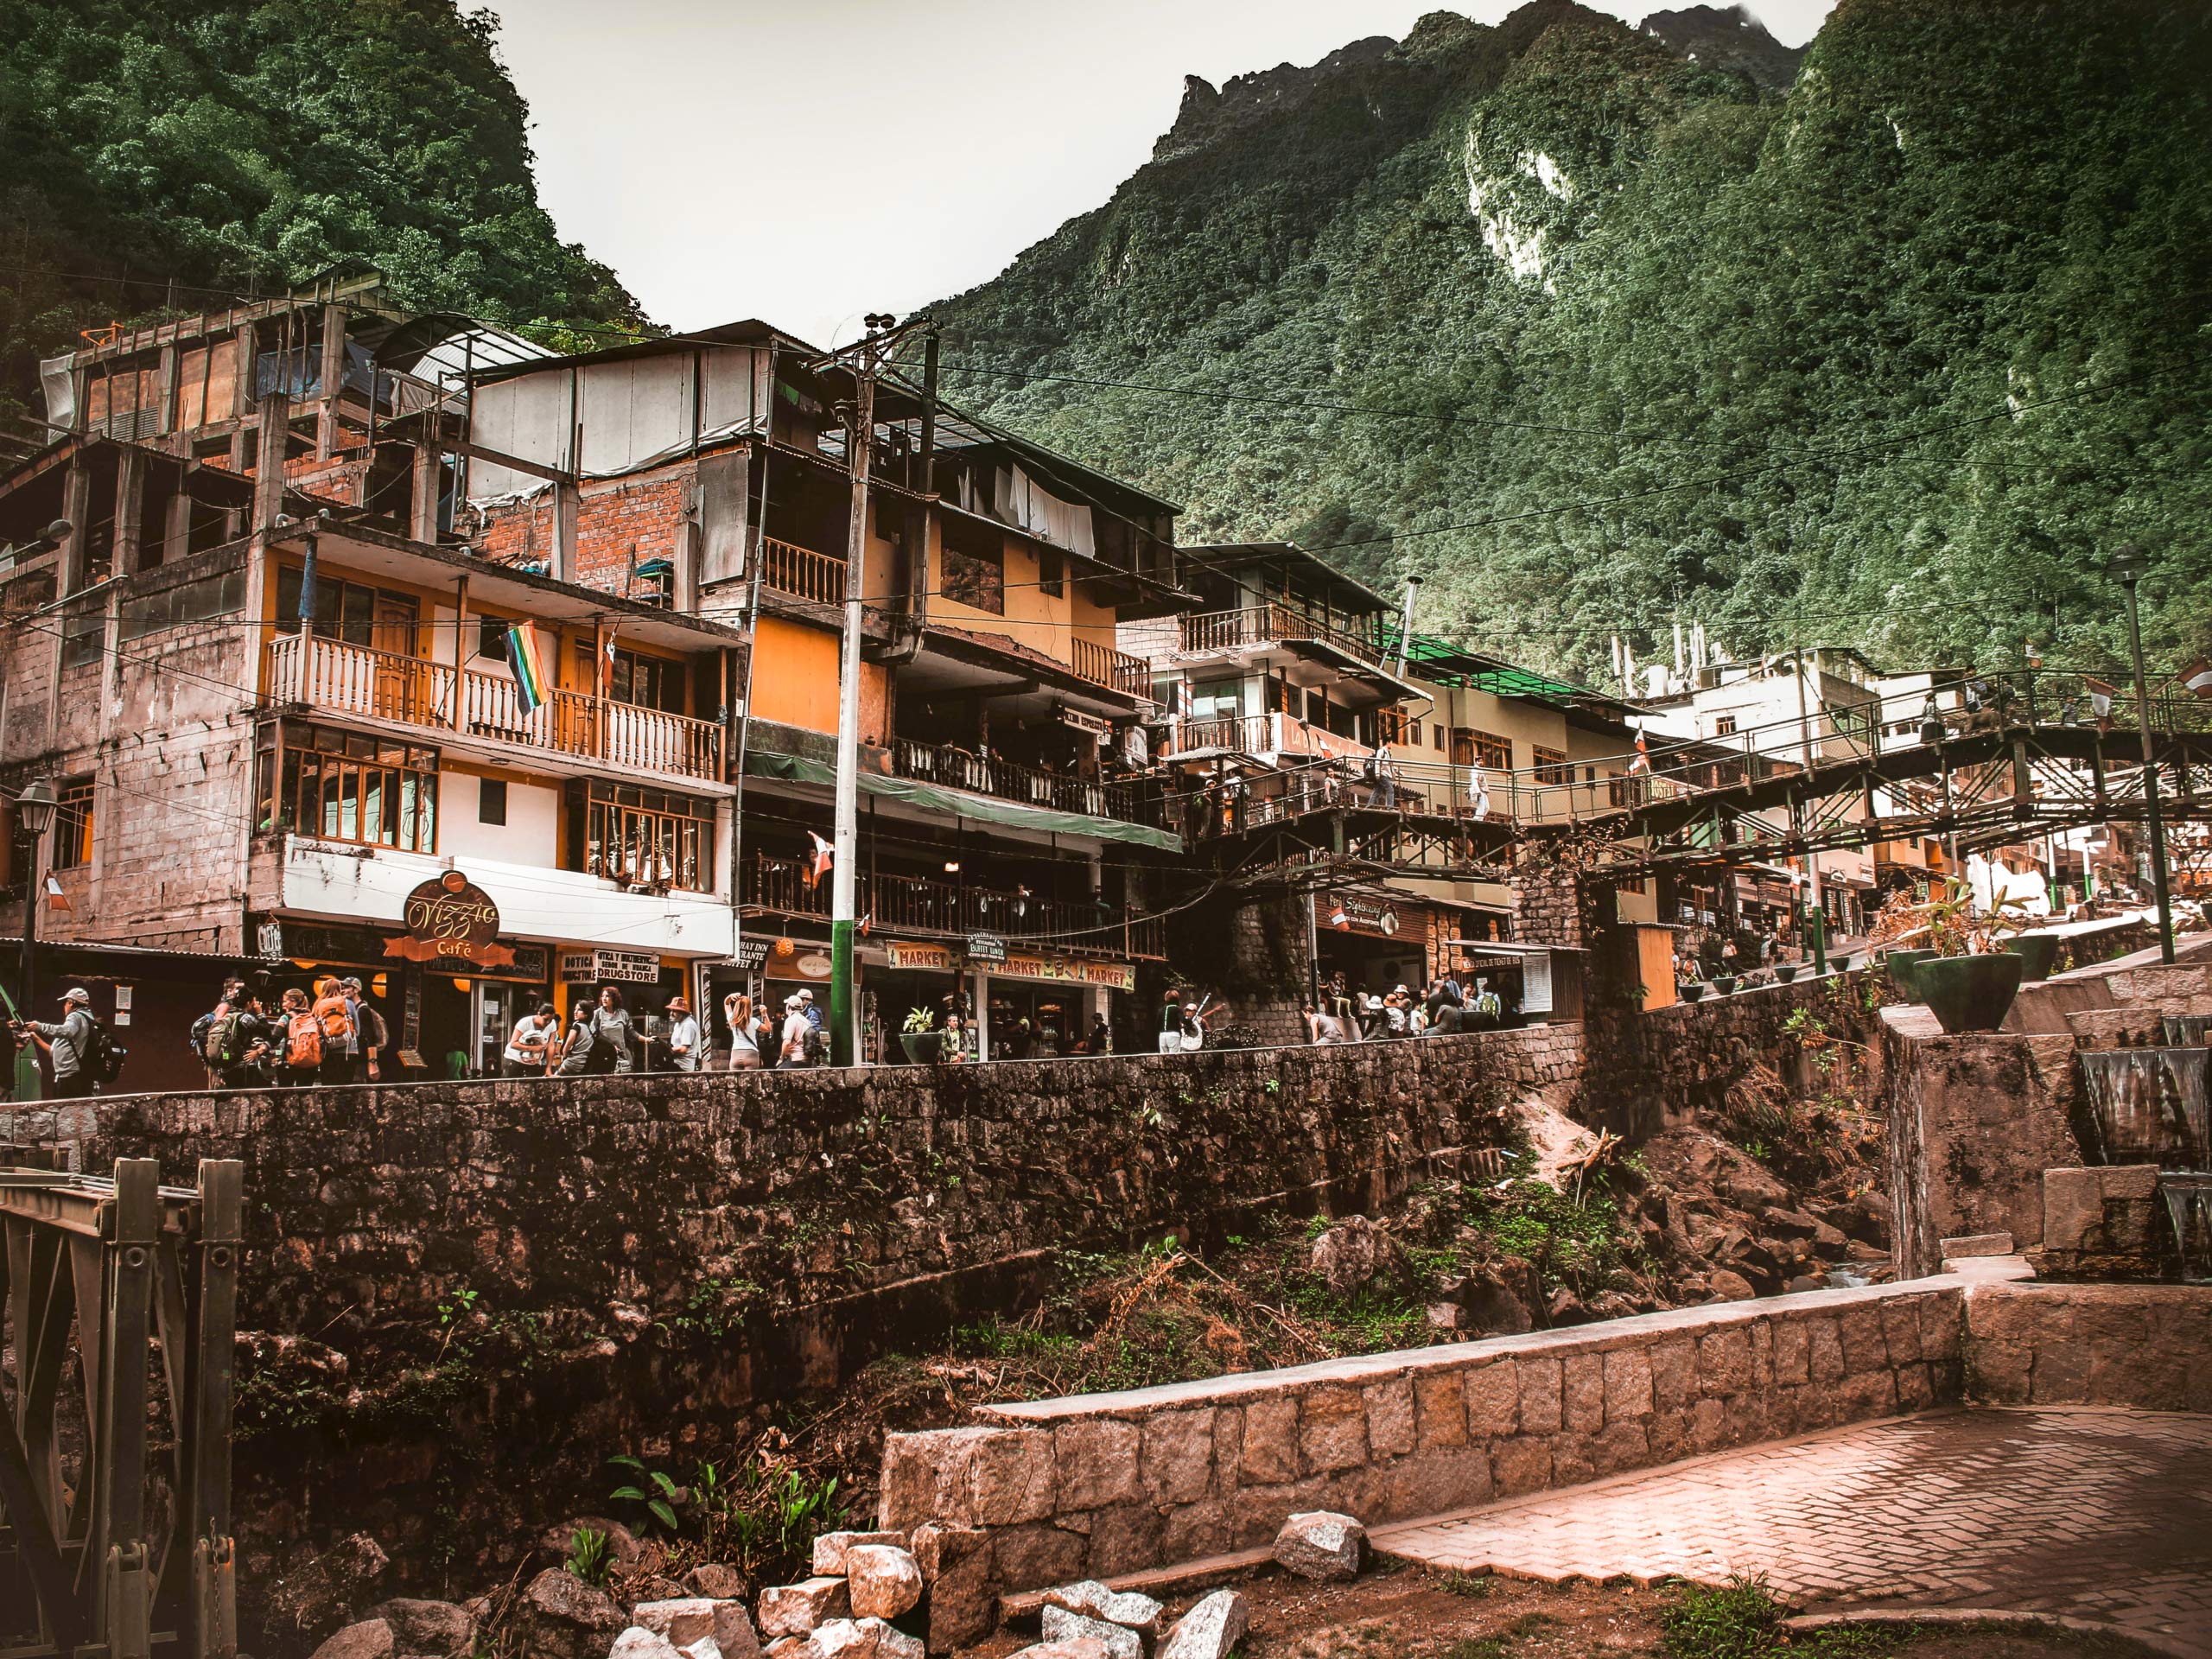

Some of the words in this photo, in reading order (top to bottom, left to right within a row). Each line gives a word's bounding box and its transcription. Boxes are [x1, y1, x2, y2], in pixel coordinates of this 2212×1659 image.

[408, 893, 496, 939] Vizzio
[437, 941, 472, 957] Café
[598, 951, 613, 961] OTICA
[755, 944, 769, 952] INN
[564, 957, 594, 968] BOTICA
[899, 950, 947, 967] MARKET
[597, 968, 657, 982] DRUGSTORE
[998, 960, 1042, 977] MARKET
[1087, 968, 1126, 987] MARKET
